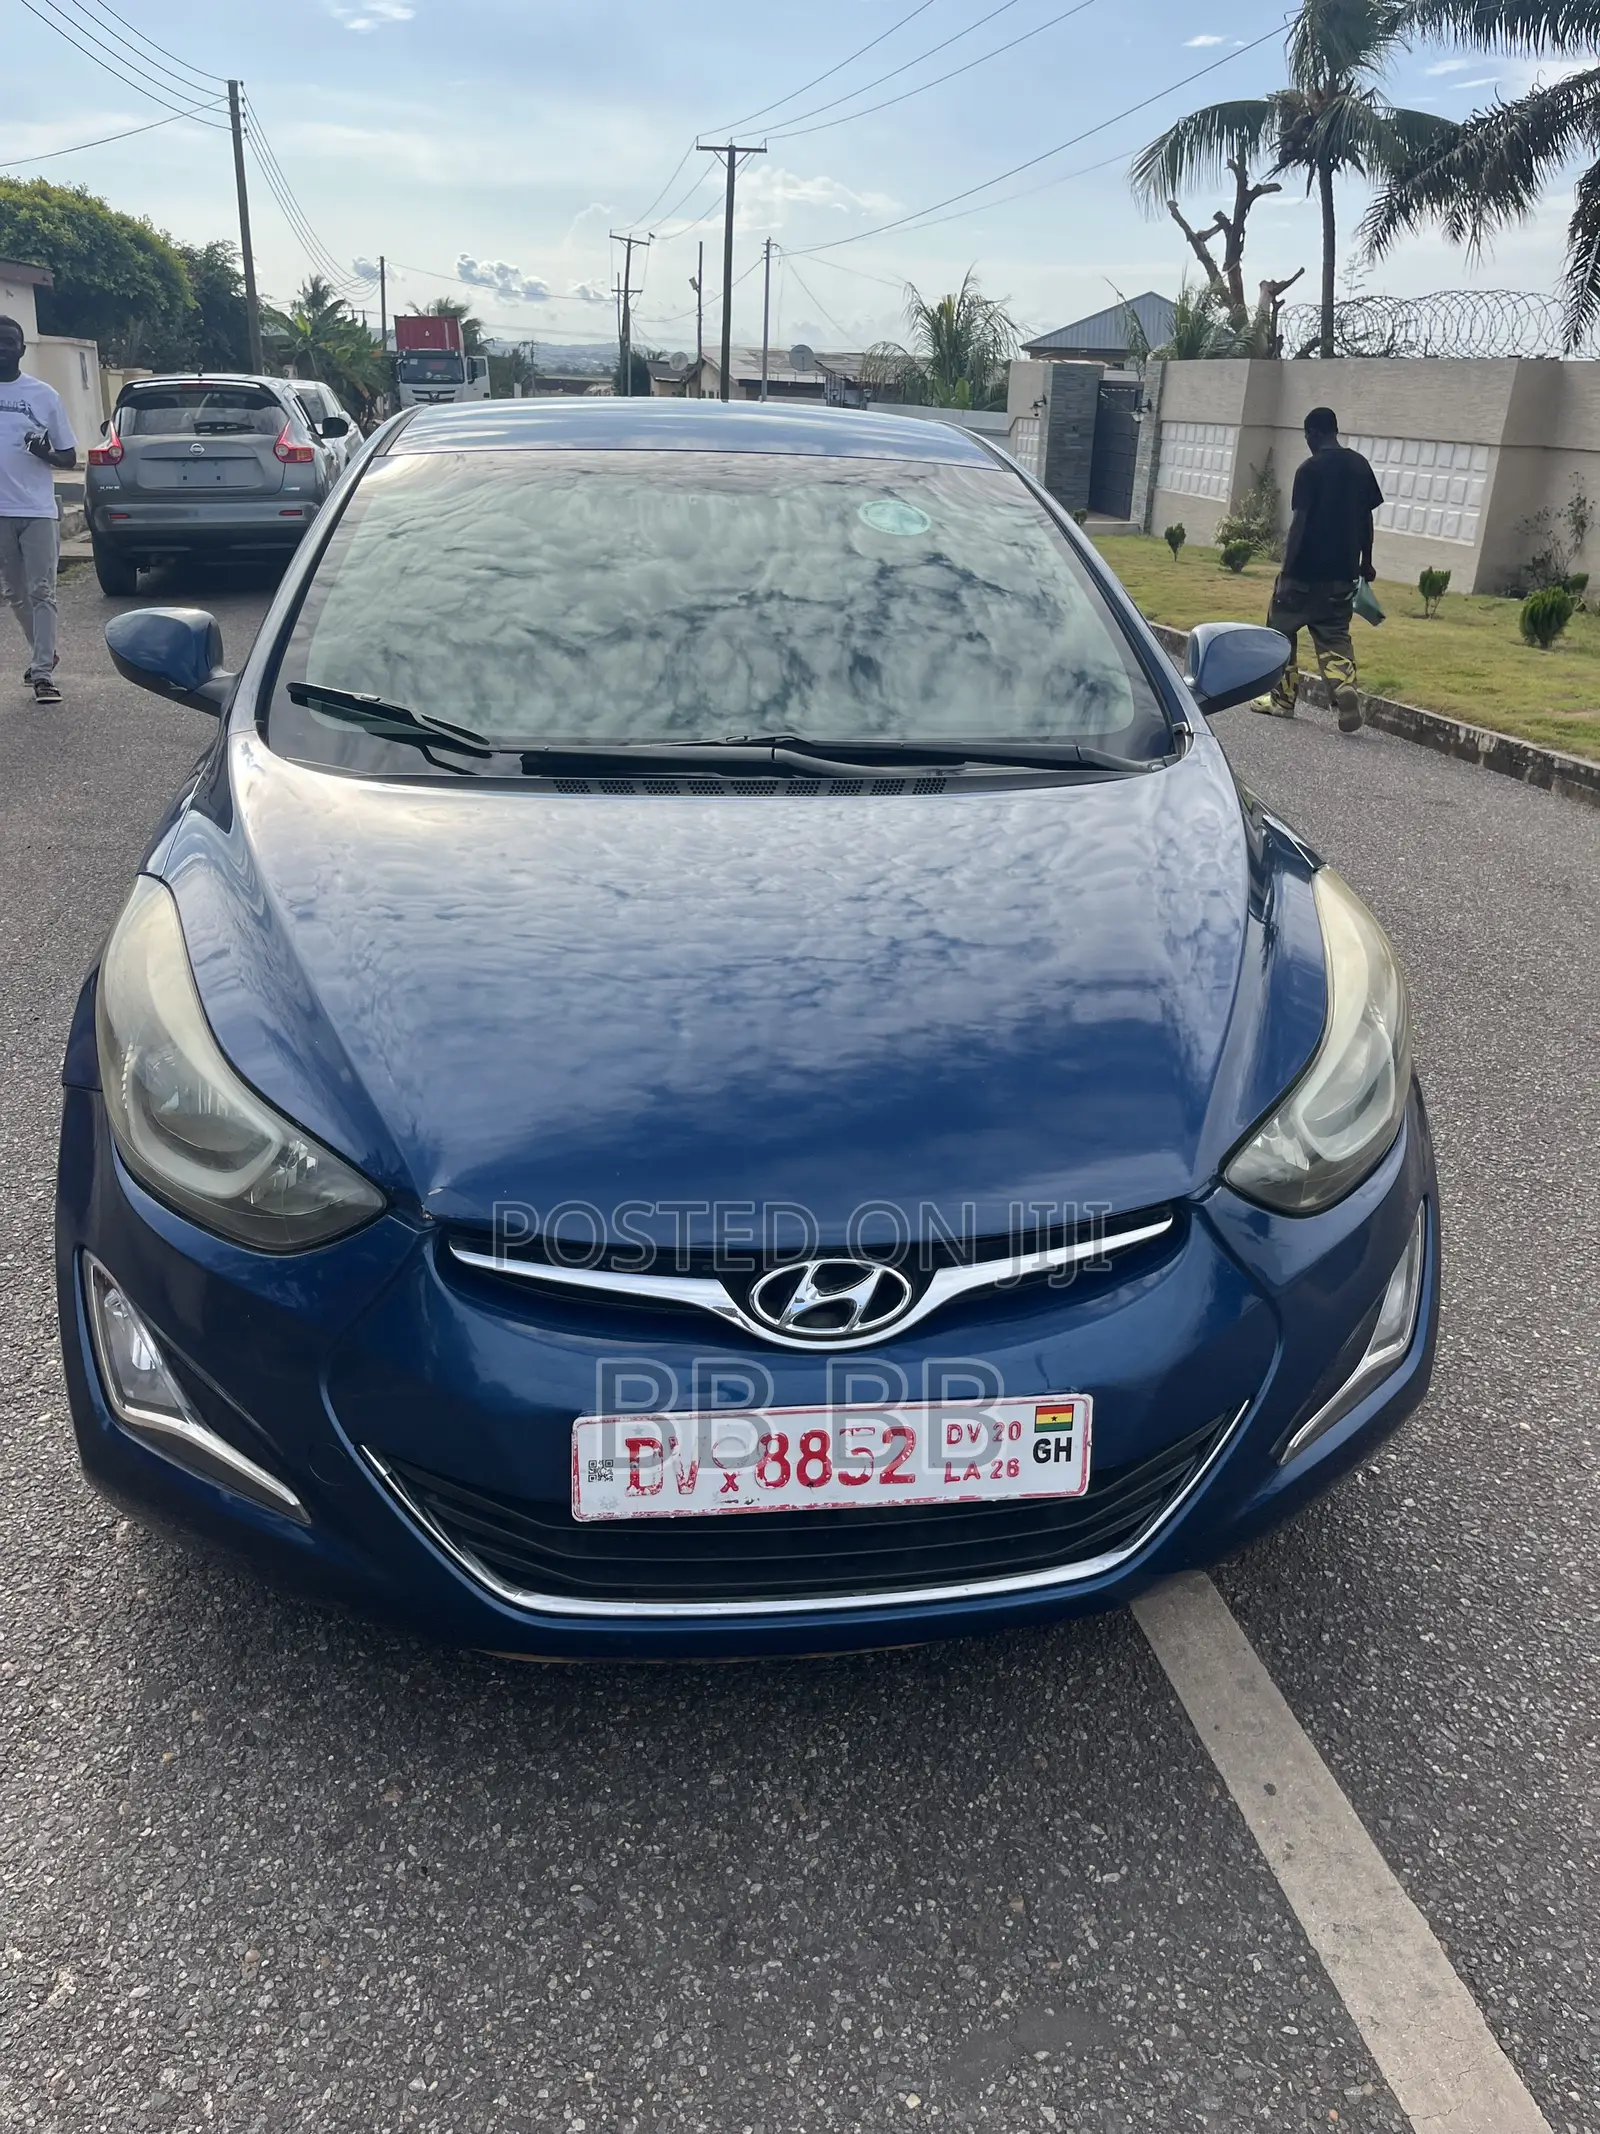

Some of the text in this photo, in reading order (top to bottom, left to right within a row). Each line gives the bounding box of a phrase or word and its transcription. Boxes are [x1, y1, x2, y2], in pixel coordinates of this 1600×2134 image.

[992, 1421, 1022, 1442] 20
[755, 1426, 917, 1489] 8852
[1032, 1437, 1073, 1464] GH
[944, 1458, 1020, 1484] LA 26
